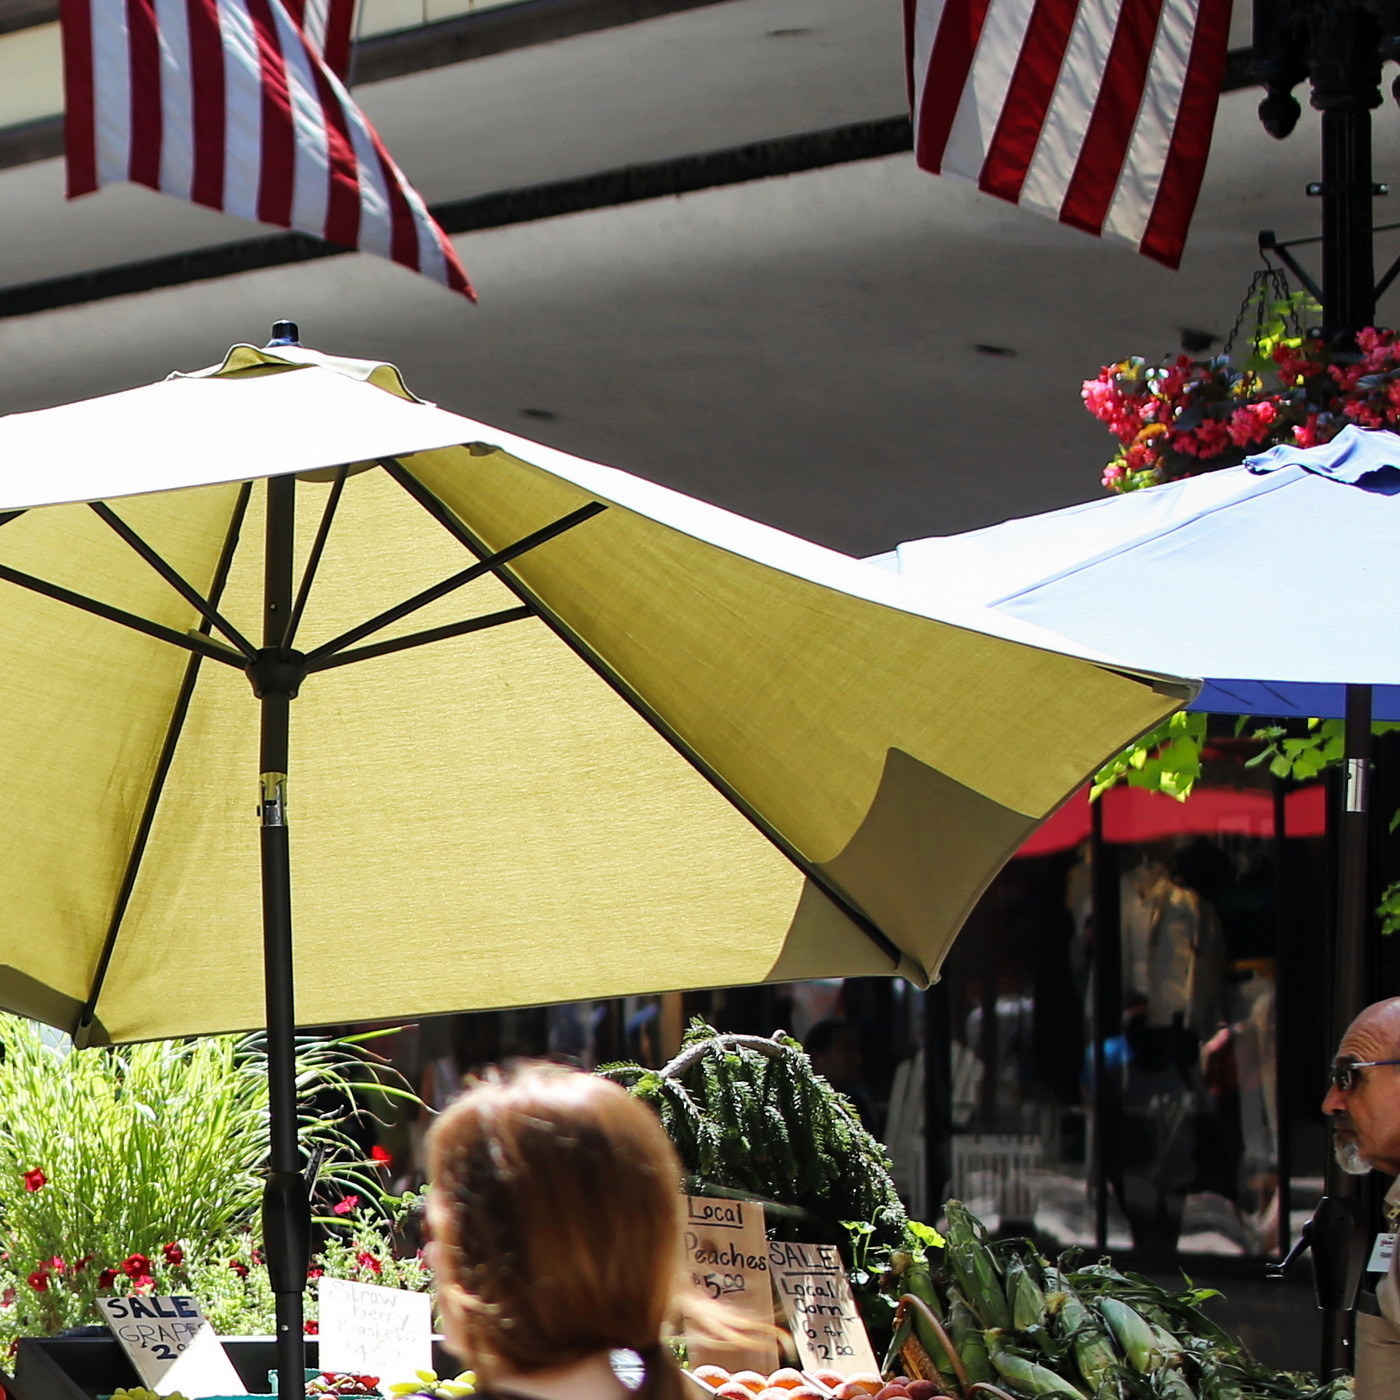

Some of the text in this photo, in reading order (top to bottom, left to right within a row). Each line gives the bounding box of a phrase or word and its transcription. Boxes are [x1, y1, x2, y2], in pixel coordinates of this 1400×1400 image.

[688, 1196, 743, 1225] Local
[684, 1231, 768, 1271] Peaches
[769, 1242, 840, 1270] SALE
[781, 1277, 836, 1299] Local
[106, 1296, 198, 1319] SALE
[795, 1298, 843, 1317] Corn
[824, 1325, 843, 1338] for
